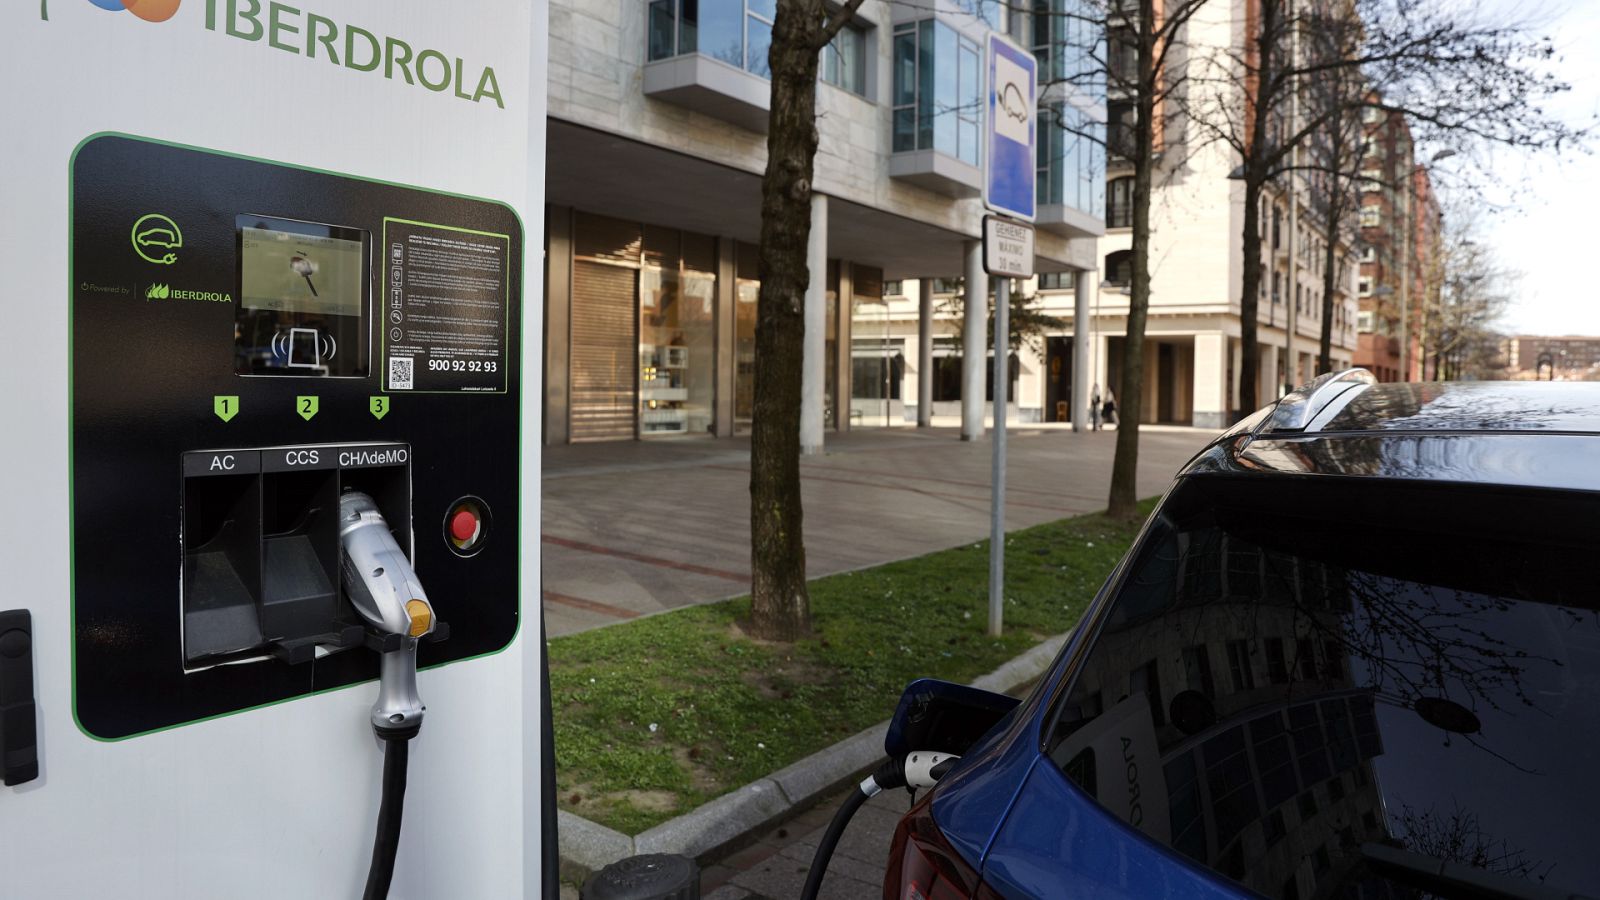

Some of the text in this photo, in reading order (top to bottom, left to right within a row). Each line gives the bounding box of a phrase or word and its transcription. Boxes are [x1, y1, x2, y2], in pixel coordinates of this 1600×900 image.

[205, 0, 505, 109] IBERDROLA
[89, 283, 130, 295] Powered by
[171, 289, 232, 303] IBERDROLA
[429, 359, 497, 373] 900 92 92 93
[221, 399, 229, 414] 1
[302, 399, 311, 413] 2
[375, 399, 383, 413] 3
[210, 455, 235, 471] AC
[286, 450, 319, 466] CCS
